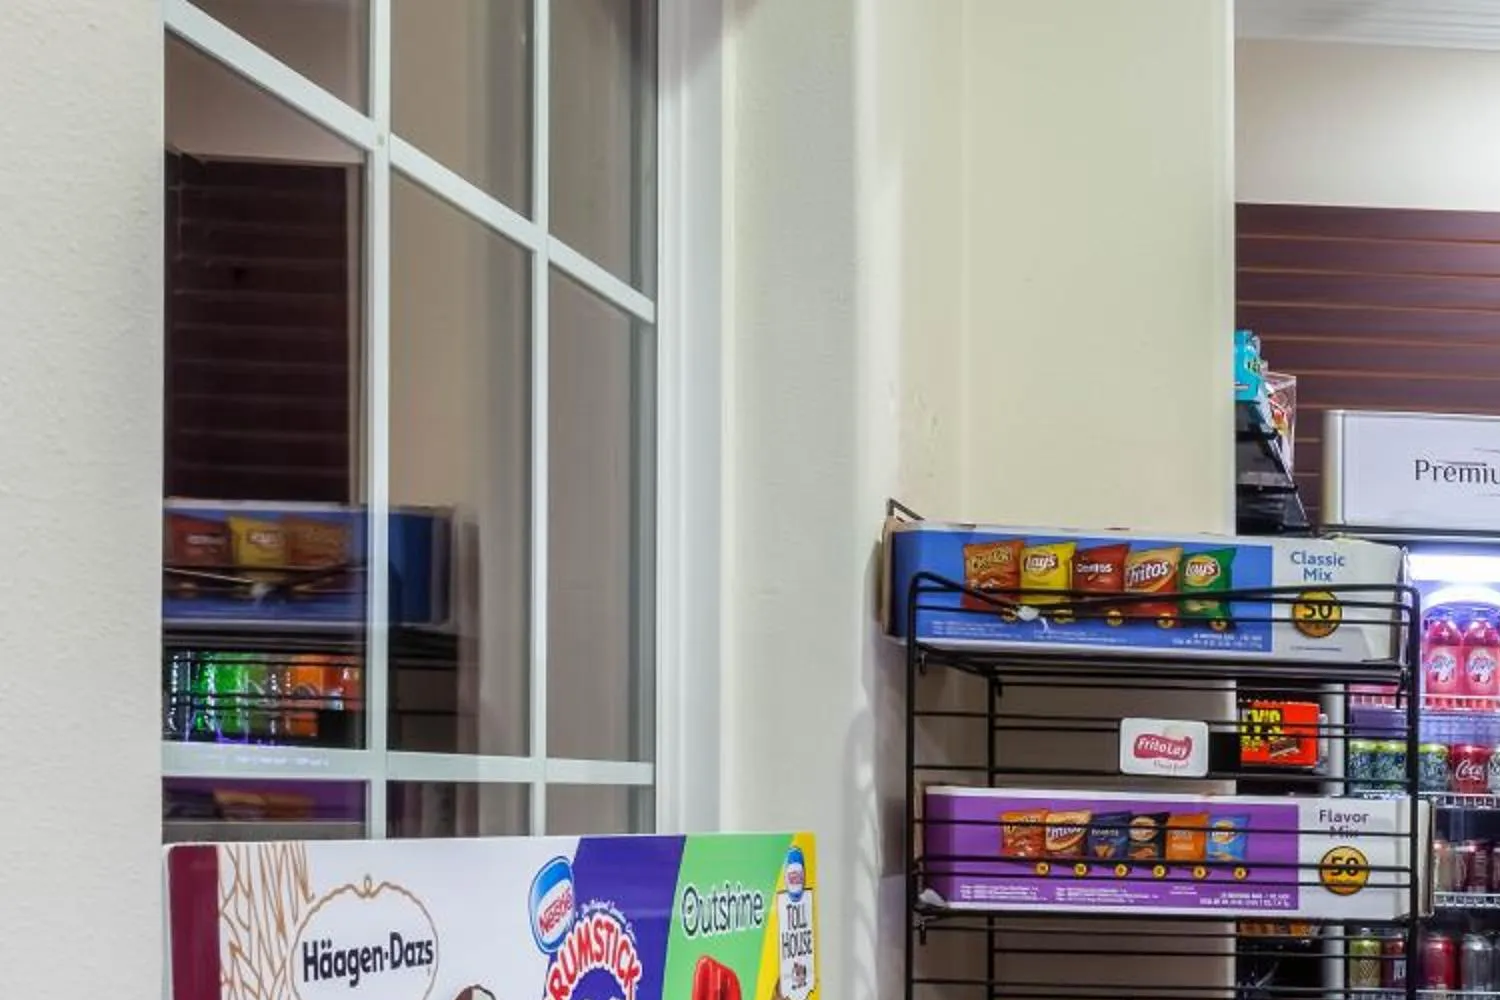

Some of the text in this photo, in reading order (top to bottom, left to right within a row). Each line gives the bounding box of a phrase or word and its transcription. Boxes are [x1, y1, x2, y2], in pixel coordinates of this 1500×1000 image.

[1291, 551, 1346, 567] Classic
[1303, 568, 1333, 582] Mix
[1303, 599, 1333, 620] 50
[1319, 809, 1370, 825] Flavor
[1329, 825, 1359, 839] Mix
[1331, 856, 1360, 877] 50
[682, 884, 763, 936] Outshine
[786, 902, 808, 931] TOLL
[782, 929, 813, 960] HOUSE
[303, 932, 433, 988] Häagen-Dazs
